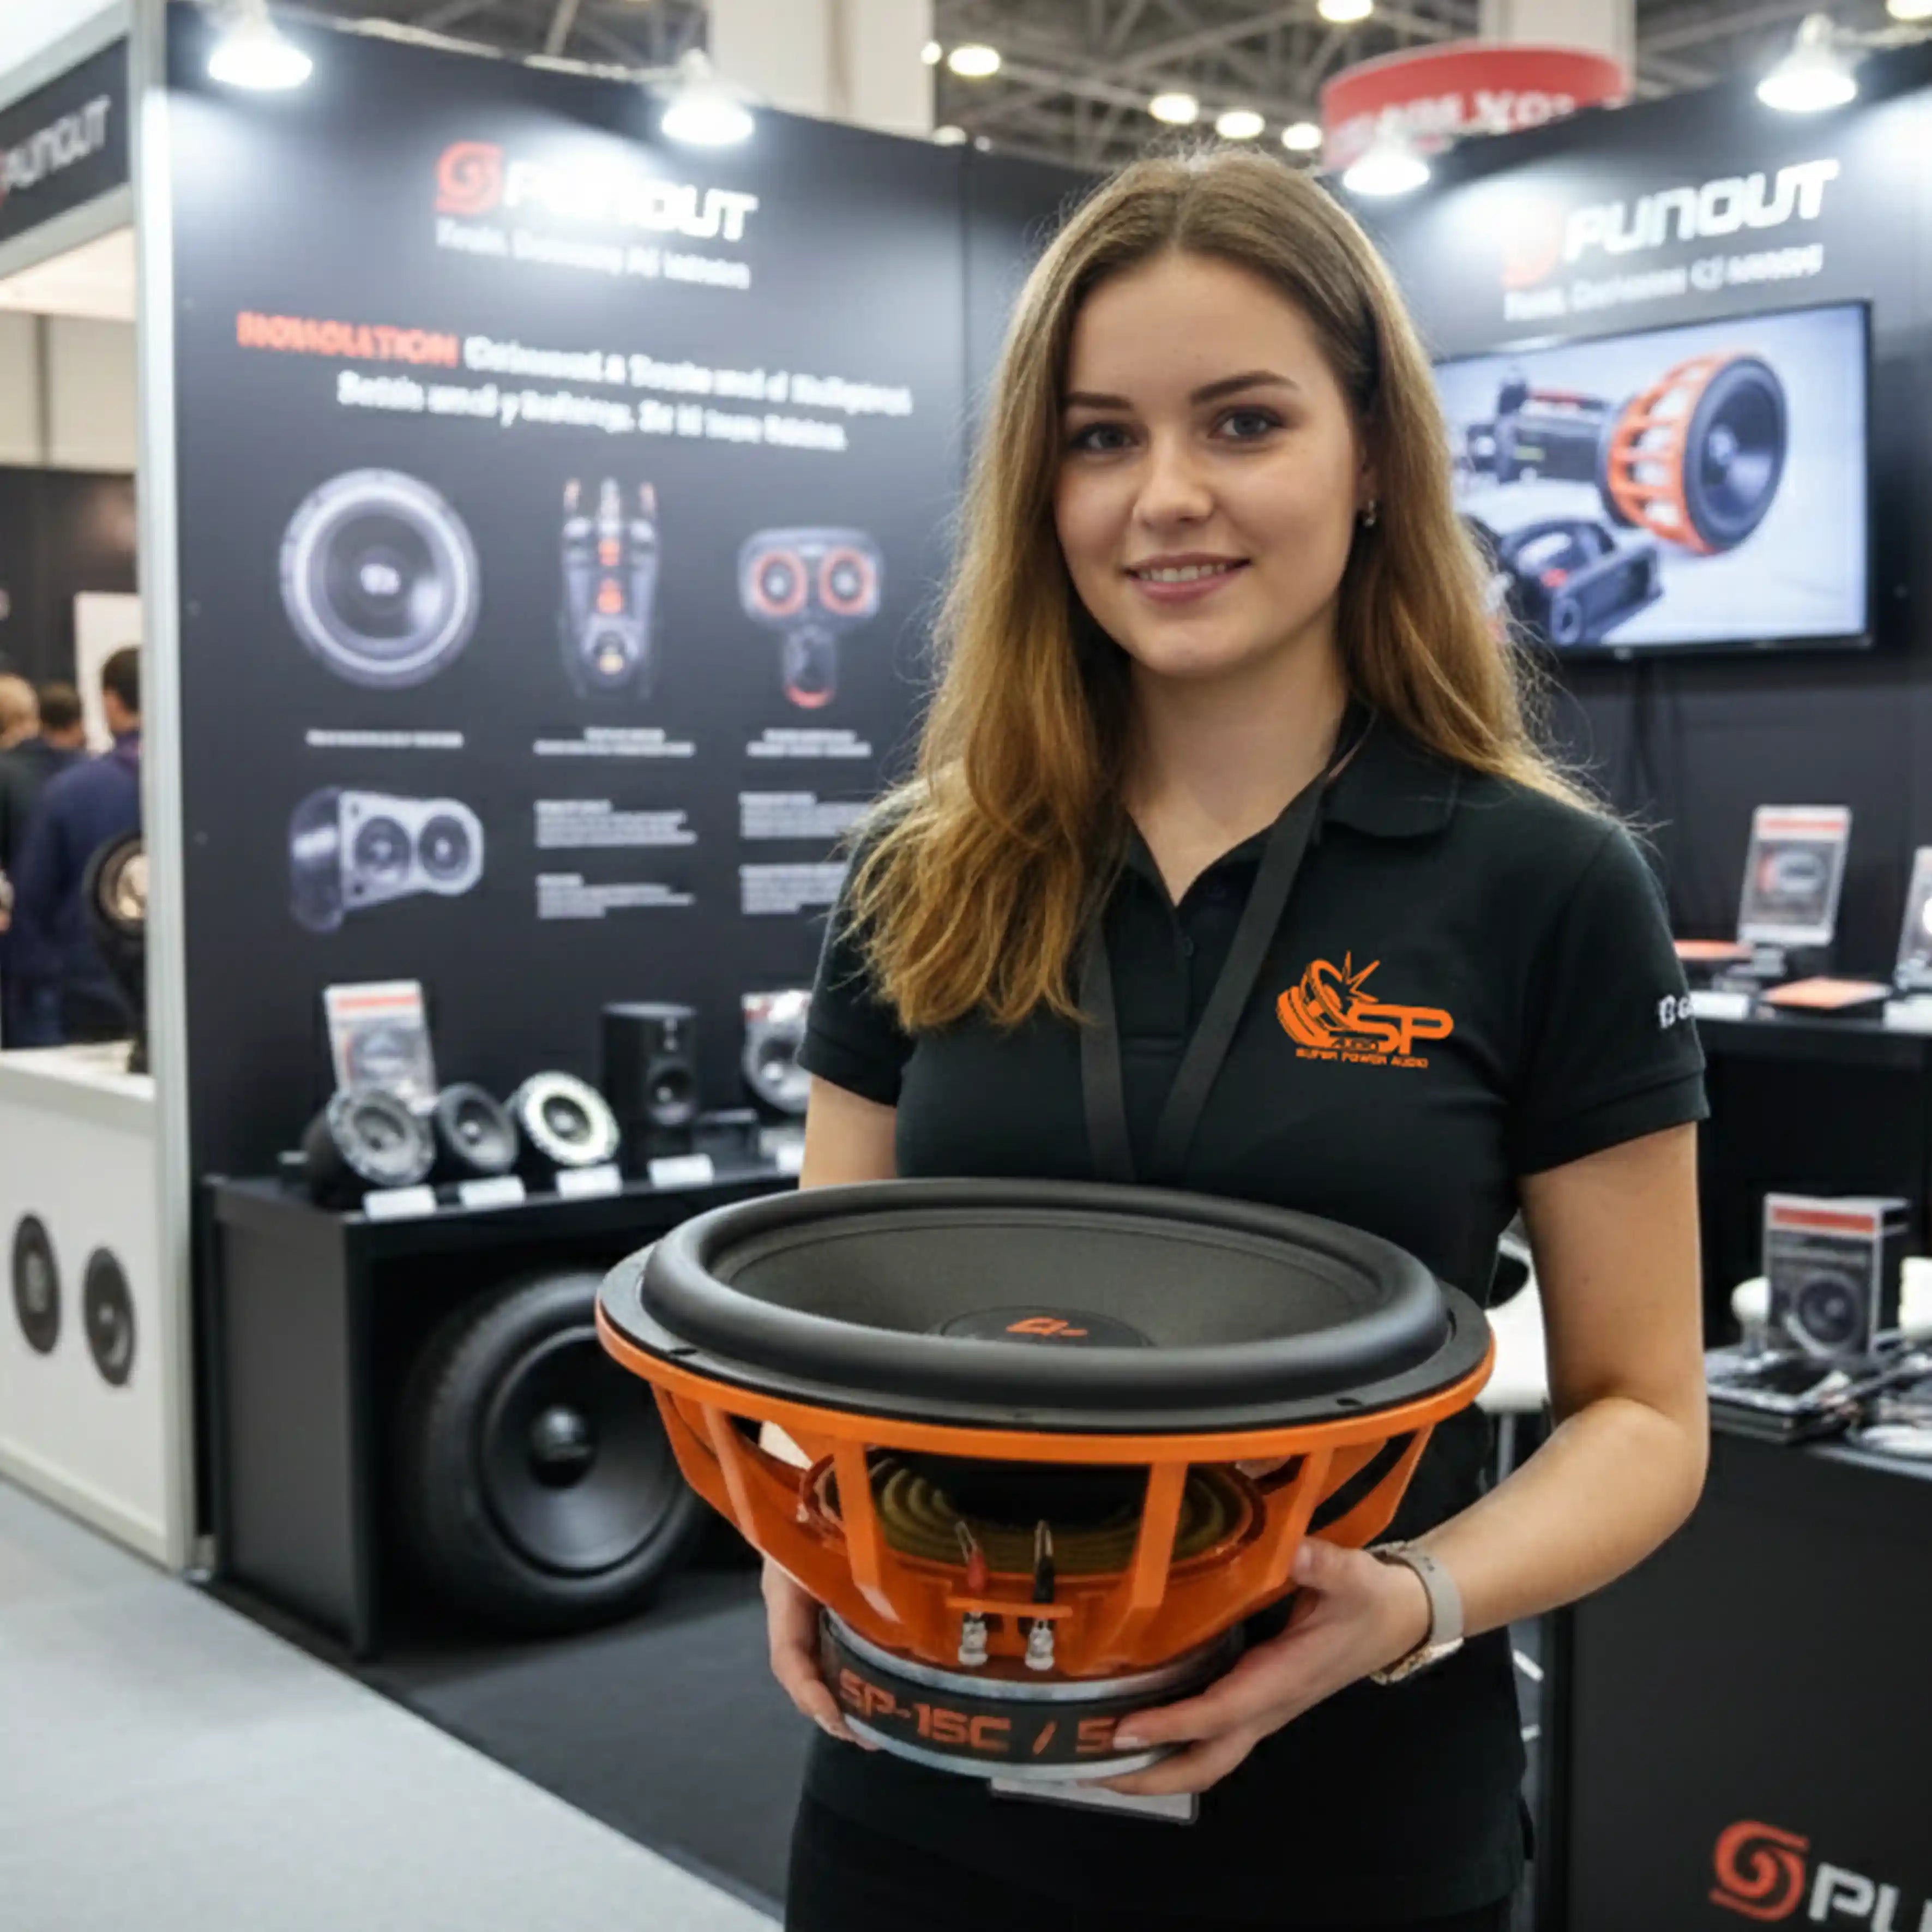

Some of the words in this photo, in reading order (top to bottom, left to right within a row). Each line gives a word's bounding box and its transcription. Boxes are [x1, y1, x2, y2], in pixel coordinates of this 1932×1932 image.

[1564, 159, 1839, 262] PUNOUT
[1341, 1050, 1387, 1065] POWER
[1390, 1056, 1429, 1069] AUDIO
